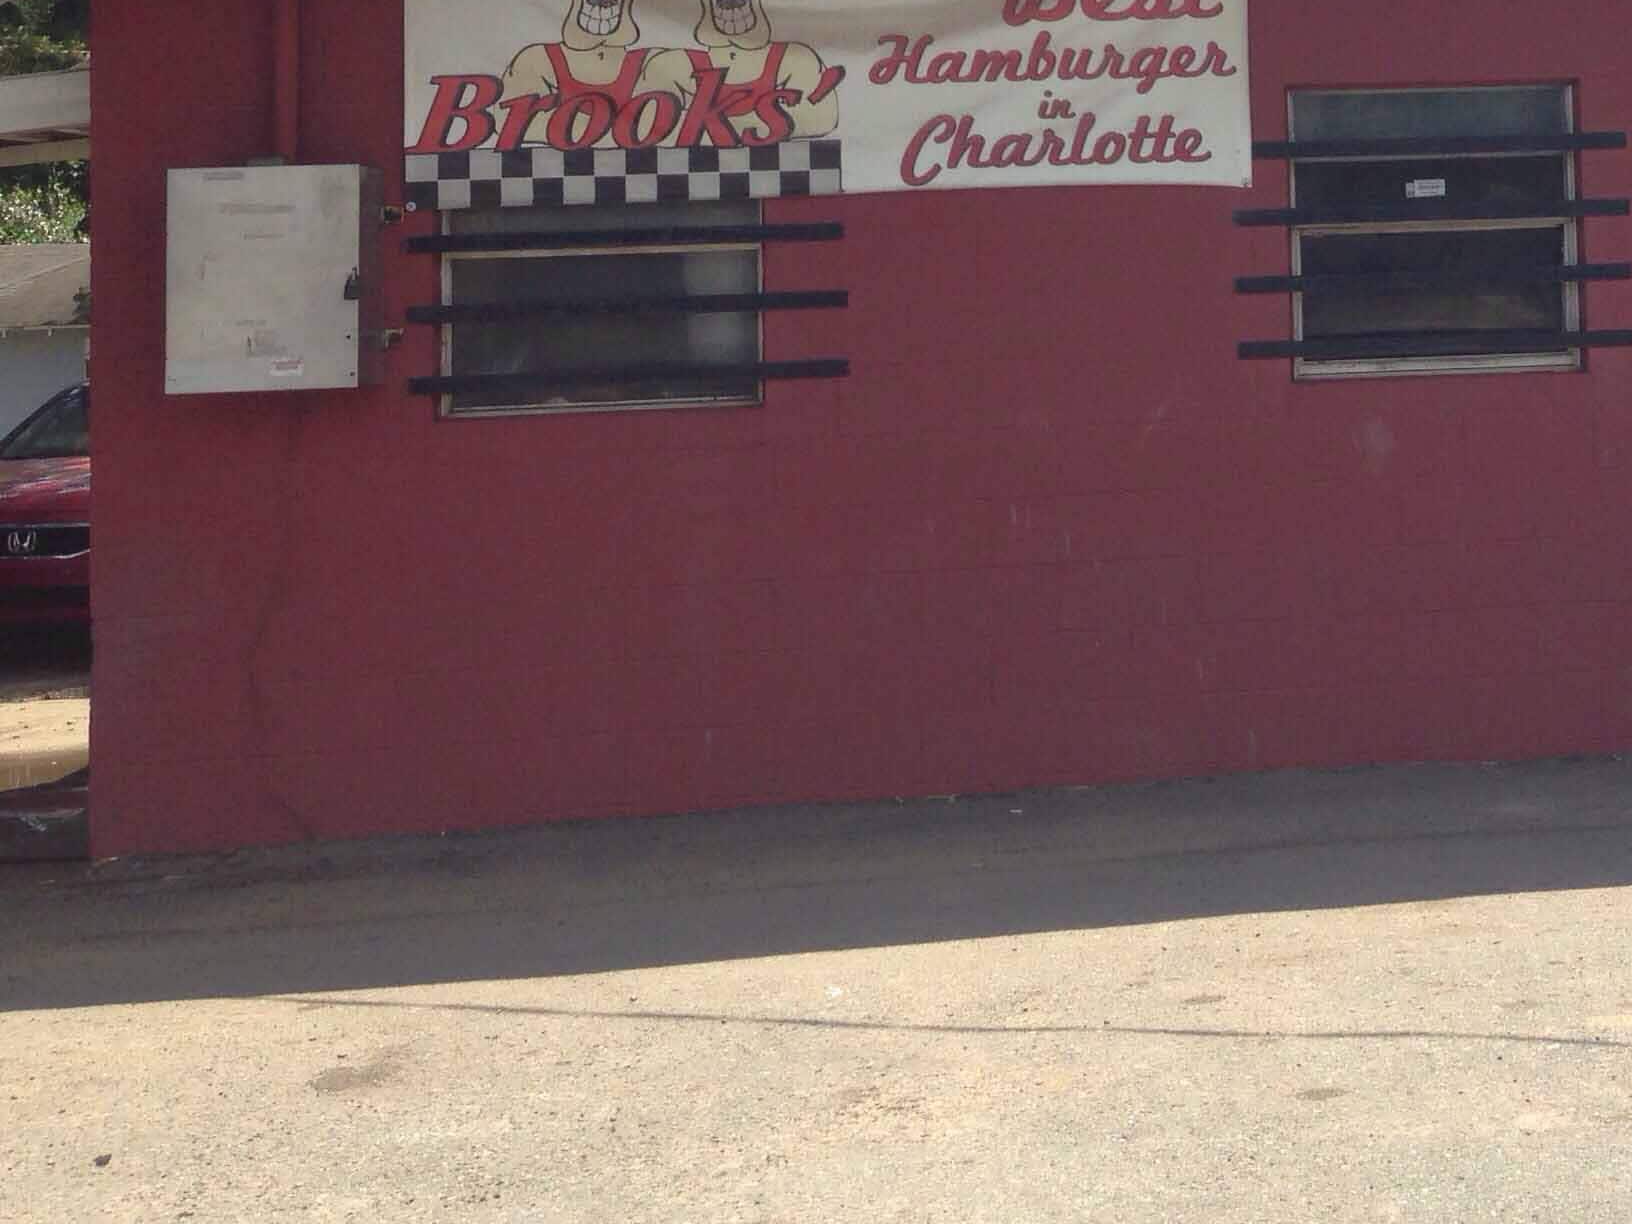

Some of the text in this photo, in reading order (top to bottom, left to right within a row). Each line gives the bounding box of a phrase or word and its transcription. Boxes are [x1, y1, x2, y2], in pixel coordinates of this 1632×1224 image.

[868, 30, 1237, 95] Hamburger
[404, 63, 847, 155] Brooks'
[1037, 89, 1077, 119] in
[899, 111, 1213, 187] Charlotte
